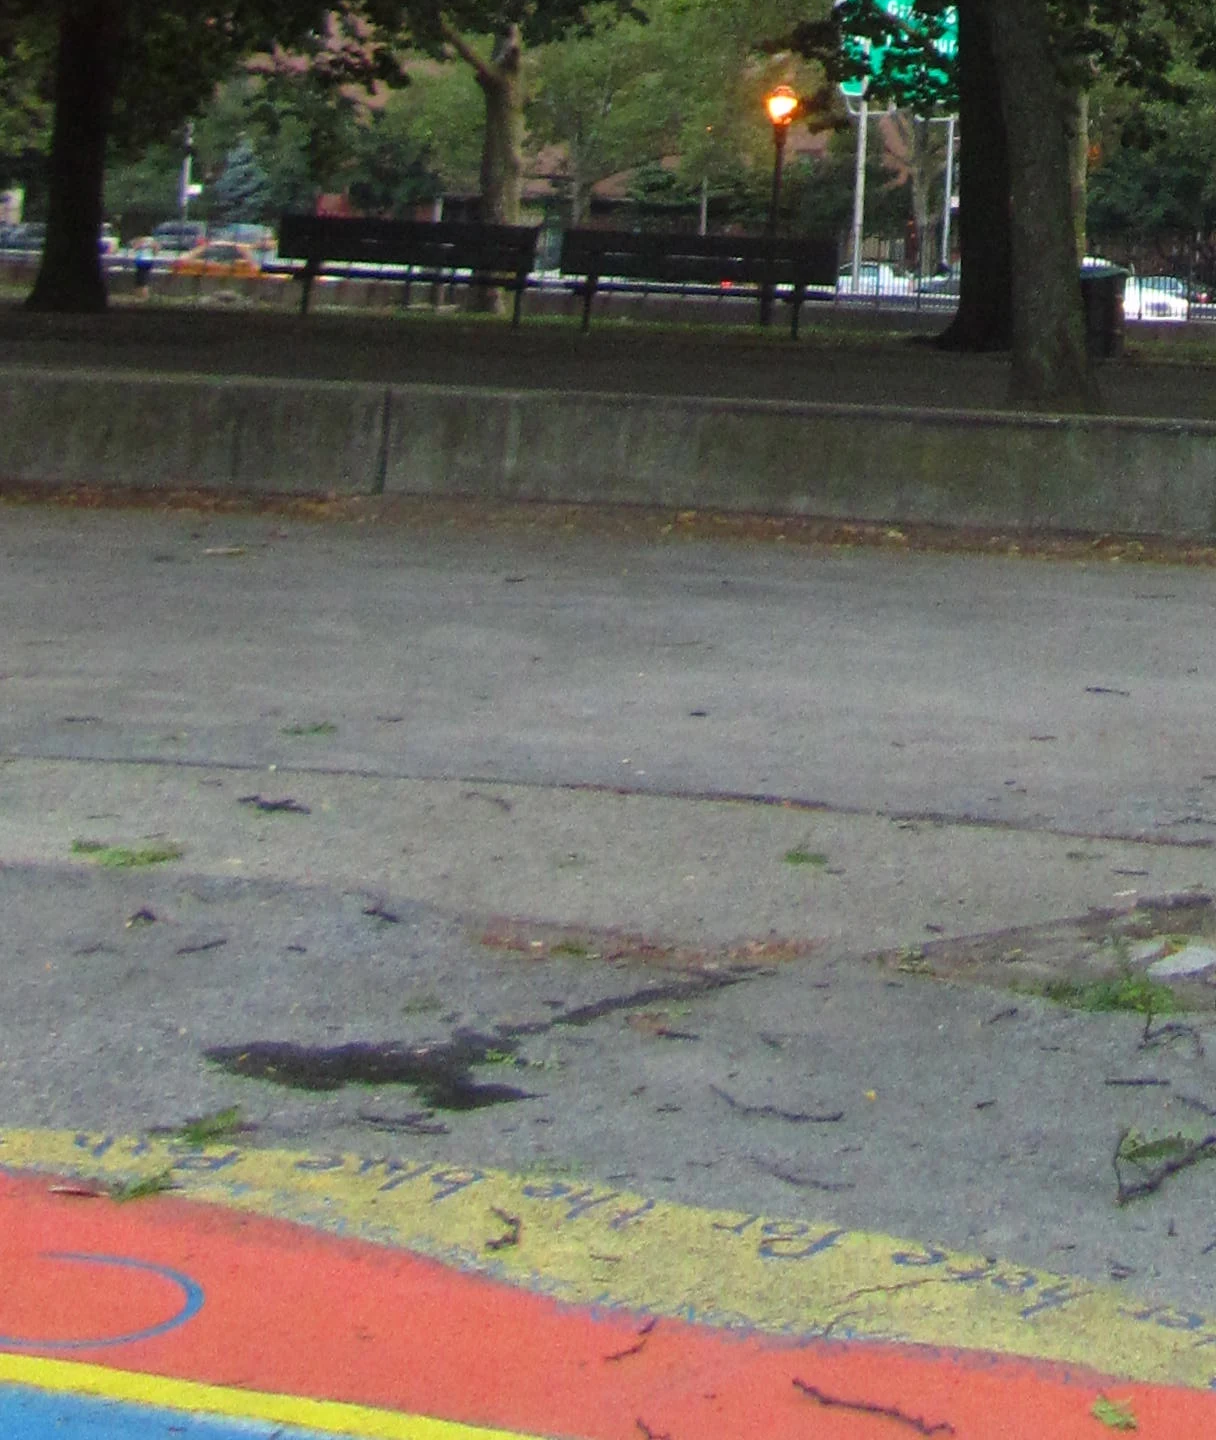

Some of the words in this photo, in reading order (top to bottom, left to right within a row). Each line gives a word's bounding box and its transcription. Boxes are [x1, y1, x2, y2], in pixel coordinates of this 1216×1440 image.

[292, 1156, 486, 1205] blue
[521, 1184, 659, 1233] the
[892, 1247, 1092, 1320] here
